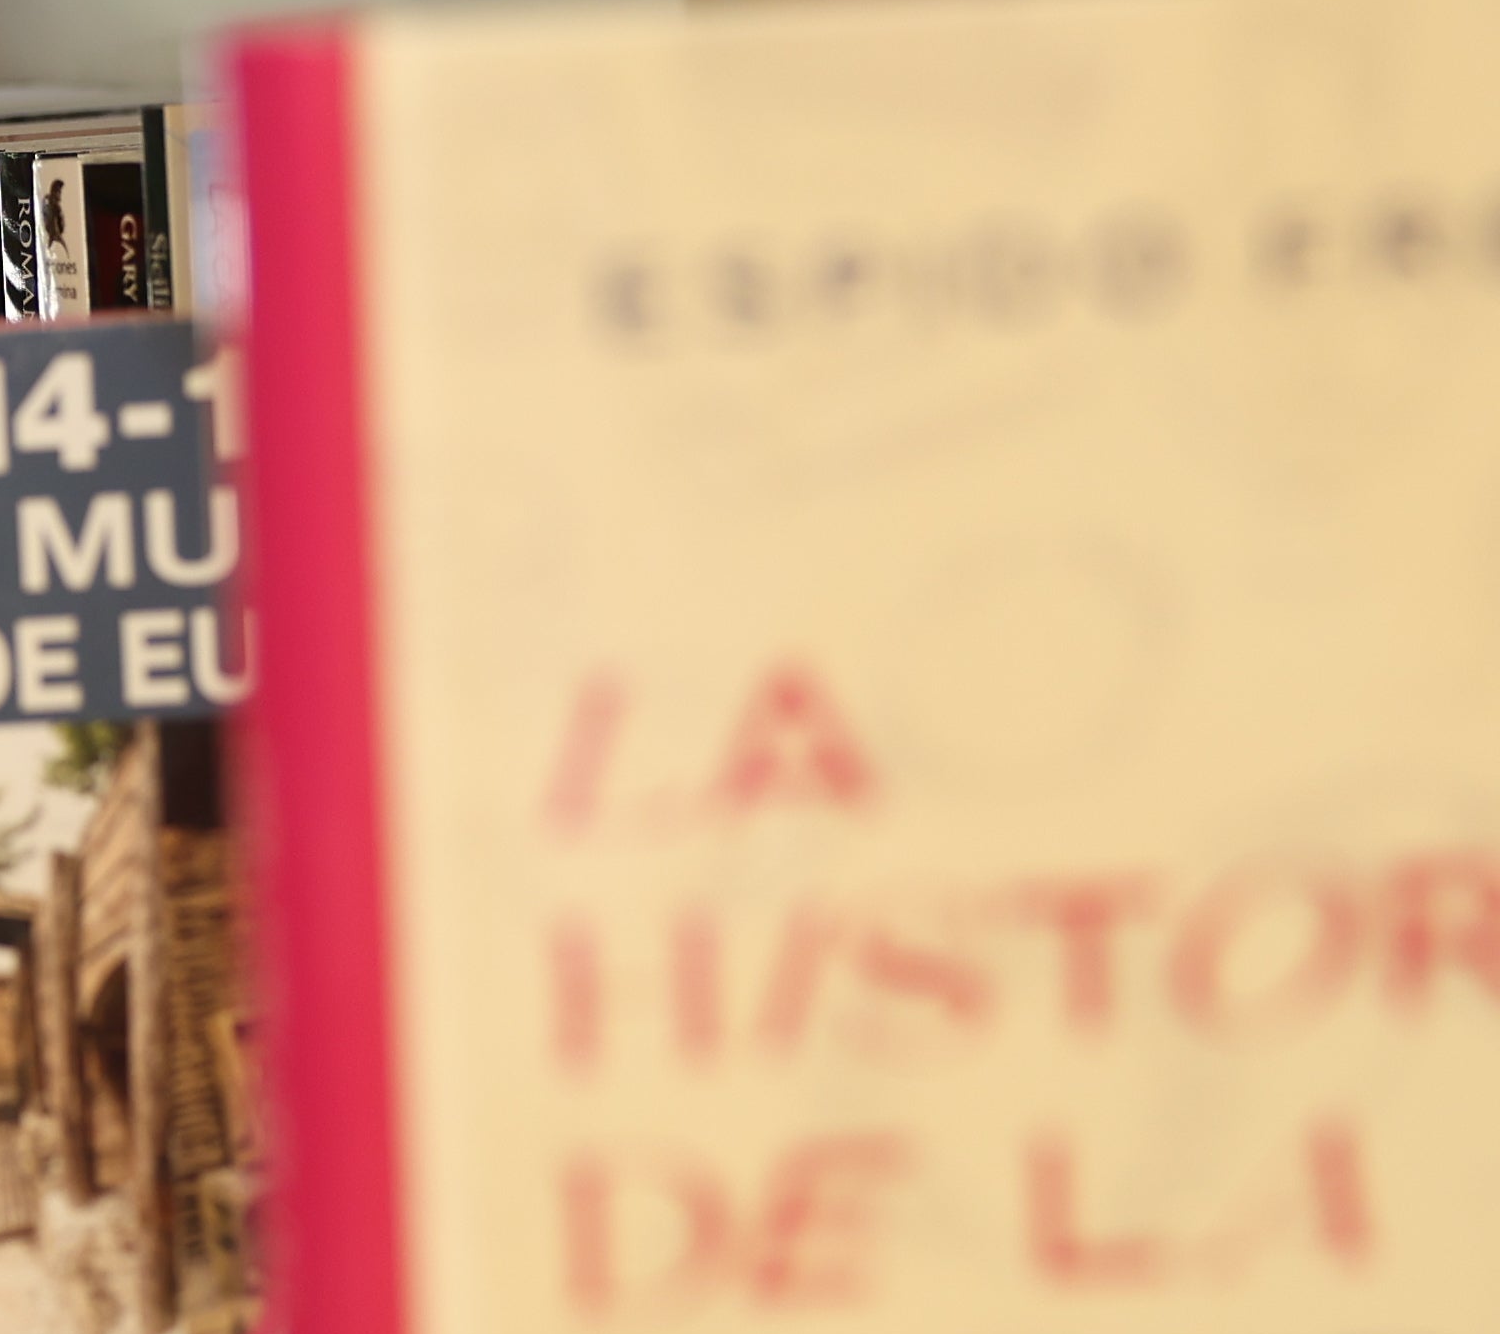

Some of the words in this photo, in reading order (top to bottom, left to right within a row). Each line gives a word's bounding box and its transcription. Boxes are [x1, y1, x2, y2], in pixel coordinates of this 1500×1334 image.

[120, 214, 138, 302] GARY
[15, 485, 241, 596] MU
[118, 607, 256, 709] EU
[545, 657, 882, 835] LA
[560, 1125, 912, 1327] DE
[1022, 1117, 1372, 1292] LA
